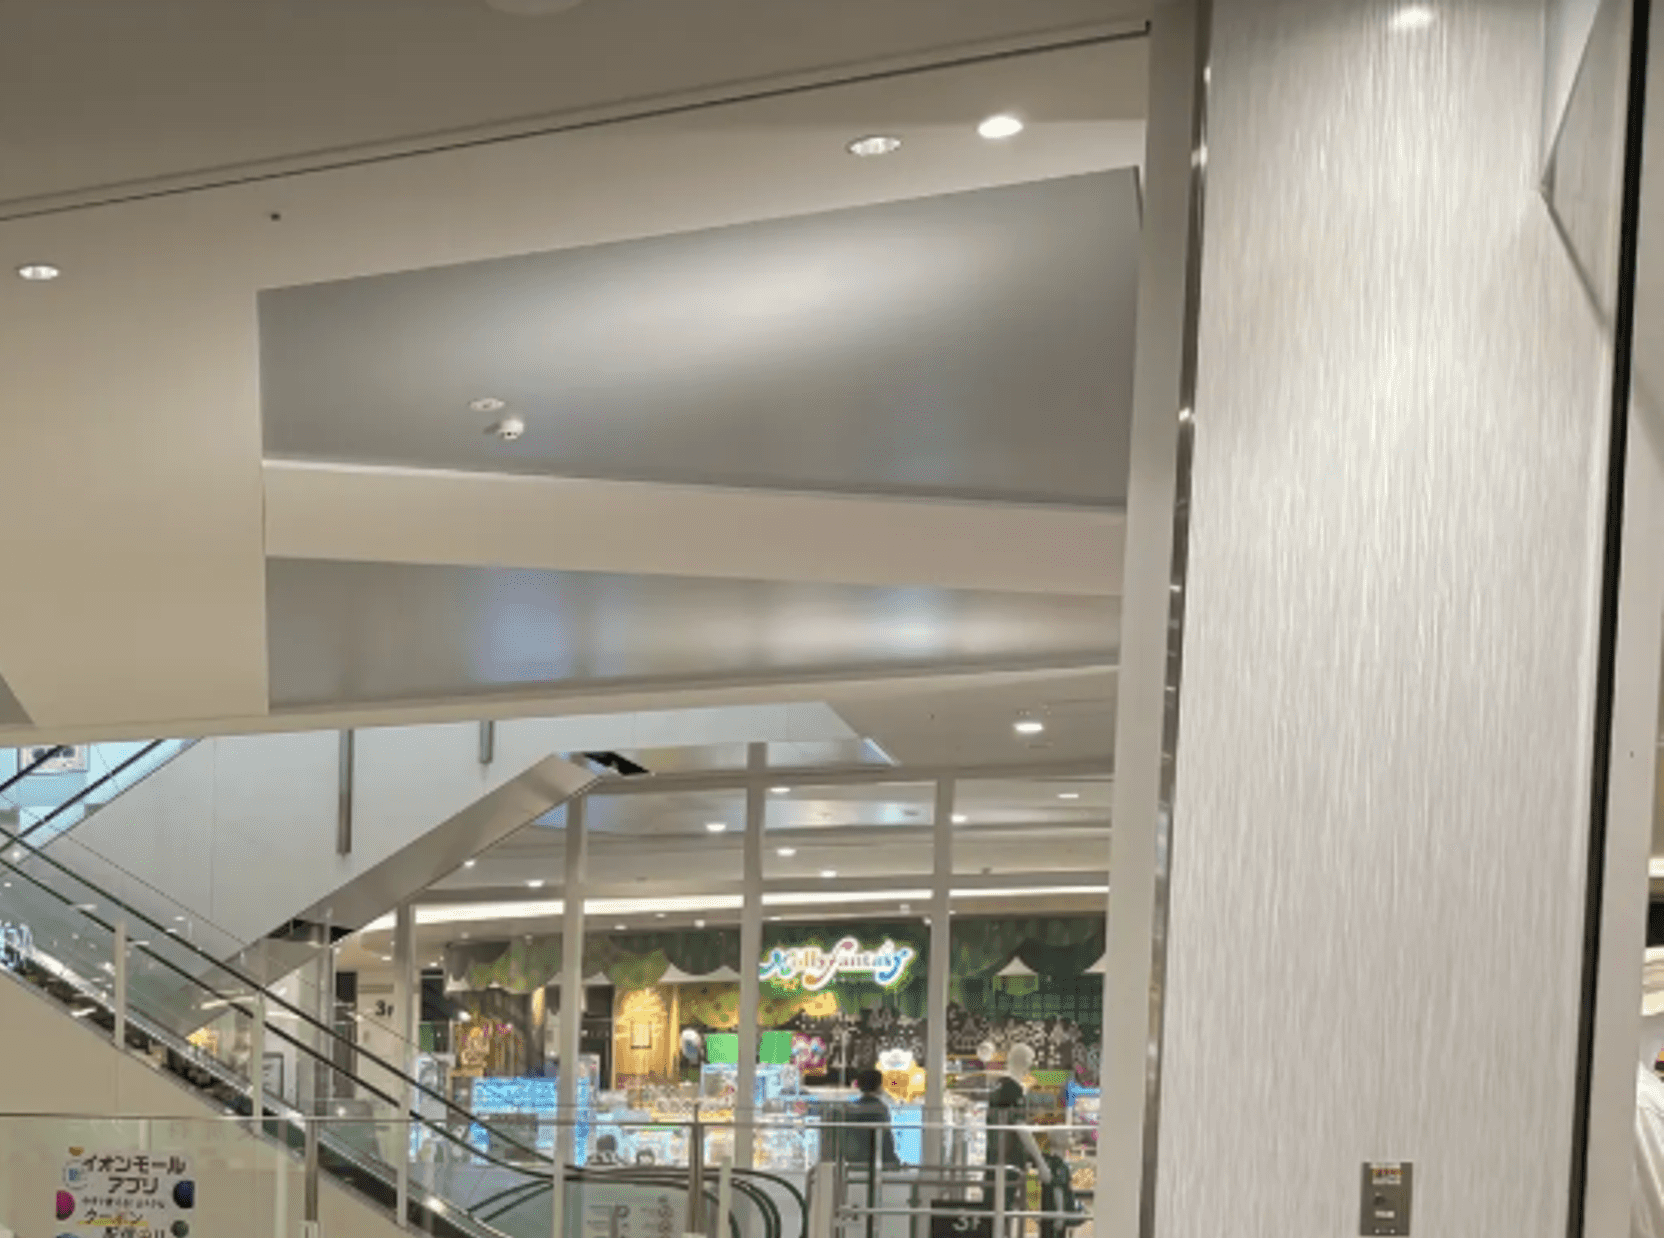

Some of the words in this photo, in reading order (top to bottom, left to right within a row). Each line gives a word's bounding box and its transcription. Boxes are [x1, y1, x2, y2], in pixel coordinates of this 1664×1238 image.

[83, 1154, 186, 1175] イオンモール
[108, 1177, 158, 1194] アプリ
